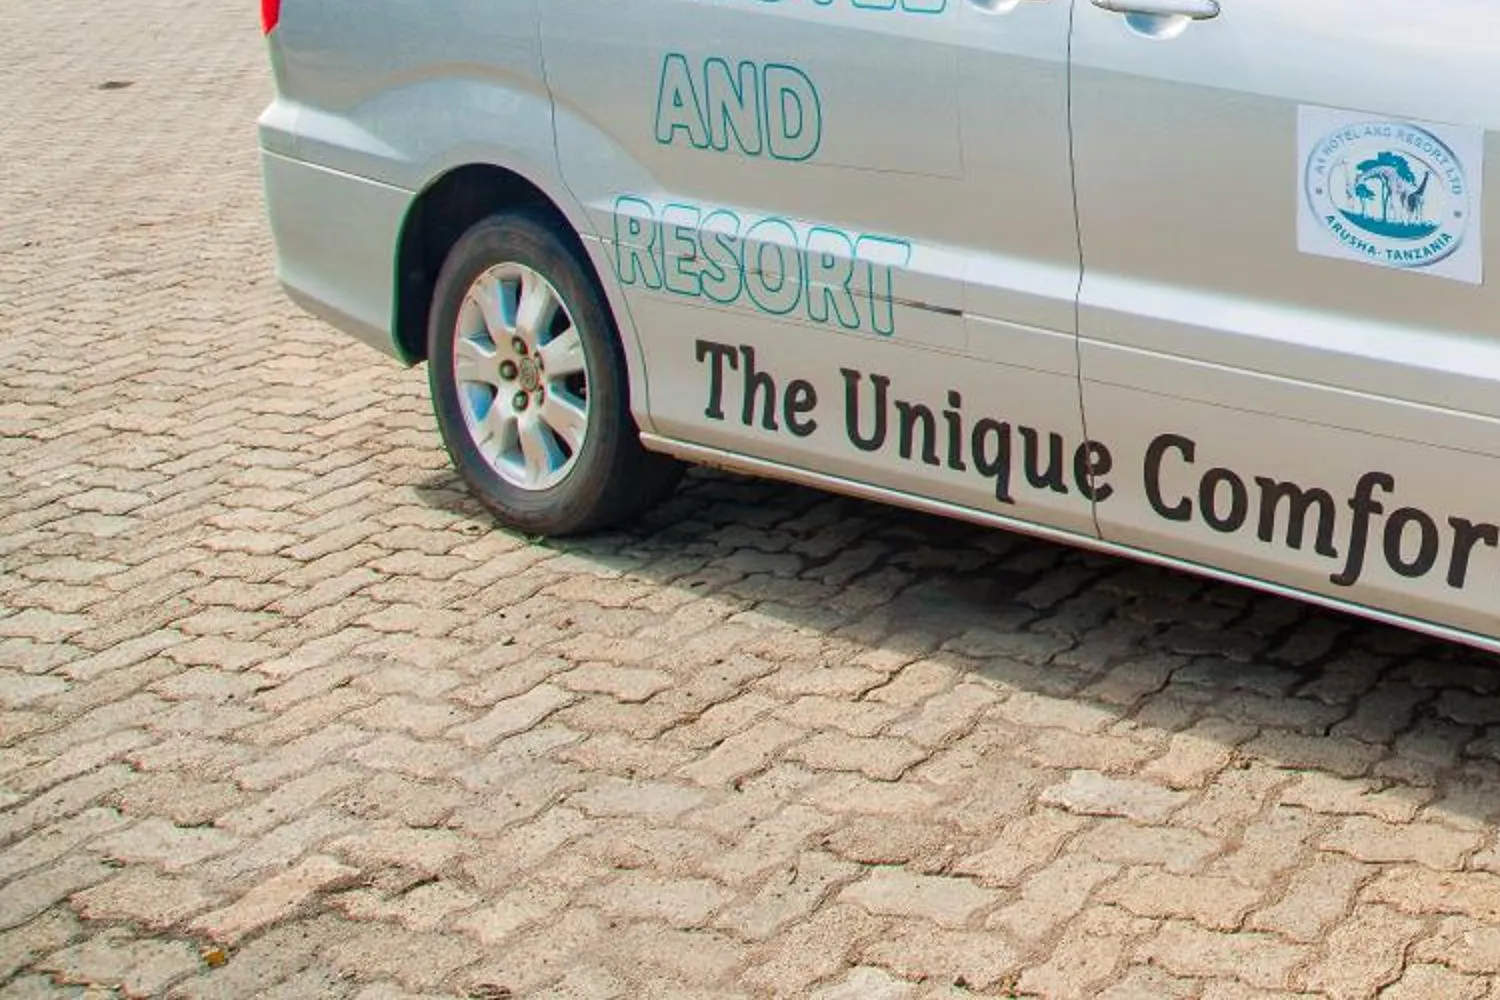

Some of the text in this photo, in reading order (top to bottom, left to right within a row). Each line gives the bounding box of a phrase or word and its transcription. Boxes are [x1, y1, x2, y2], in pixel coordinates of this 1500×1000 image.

[655, 53, 822, 161] AND
[1321, 126, 1361, 156] HOTEL
[613, 195, 912, 337] RESORT
[1385, 232, 1453, 261] TANZANIA
[695, 338, 820, 438] The
[840, 368, 1114, 504] Unique
